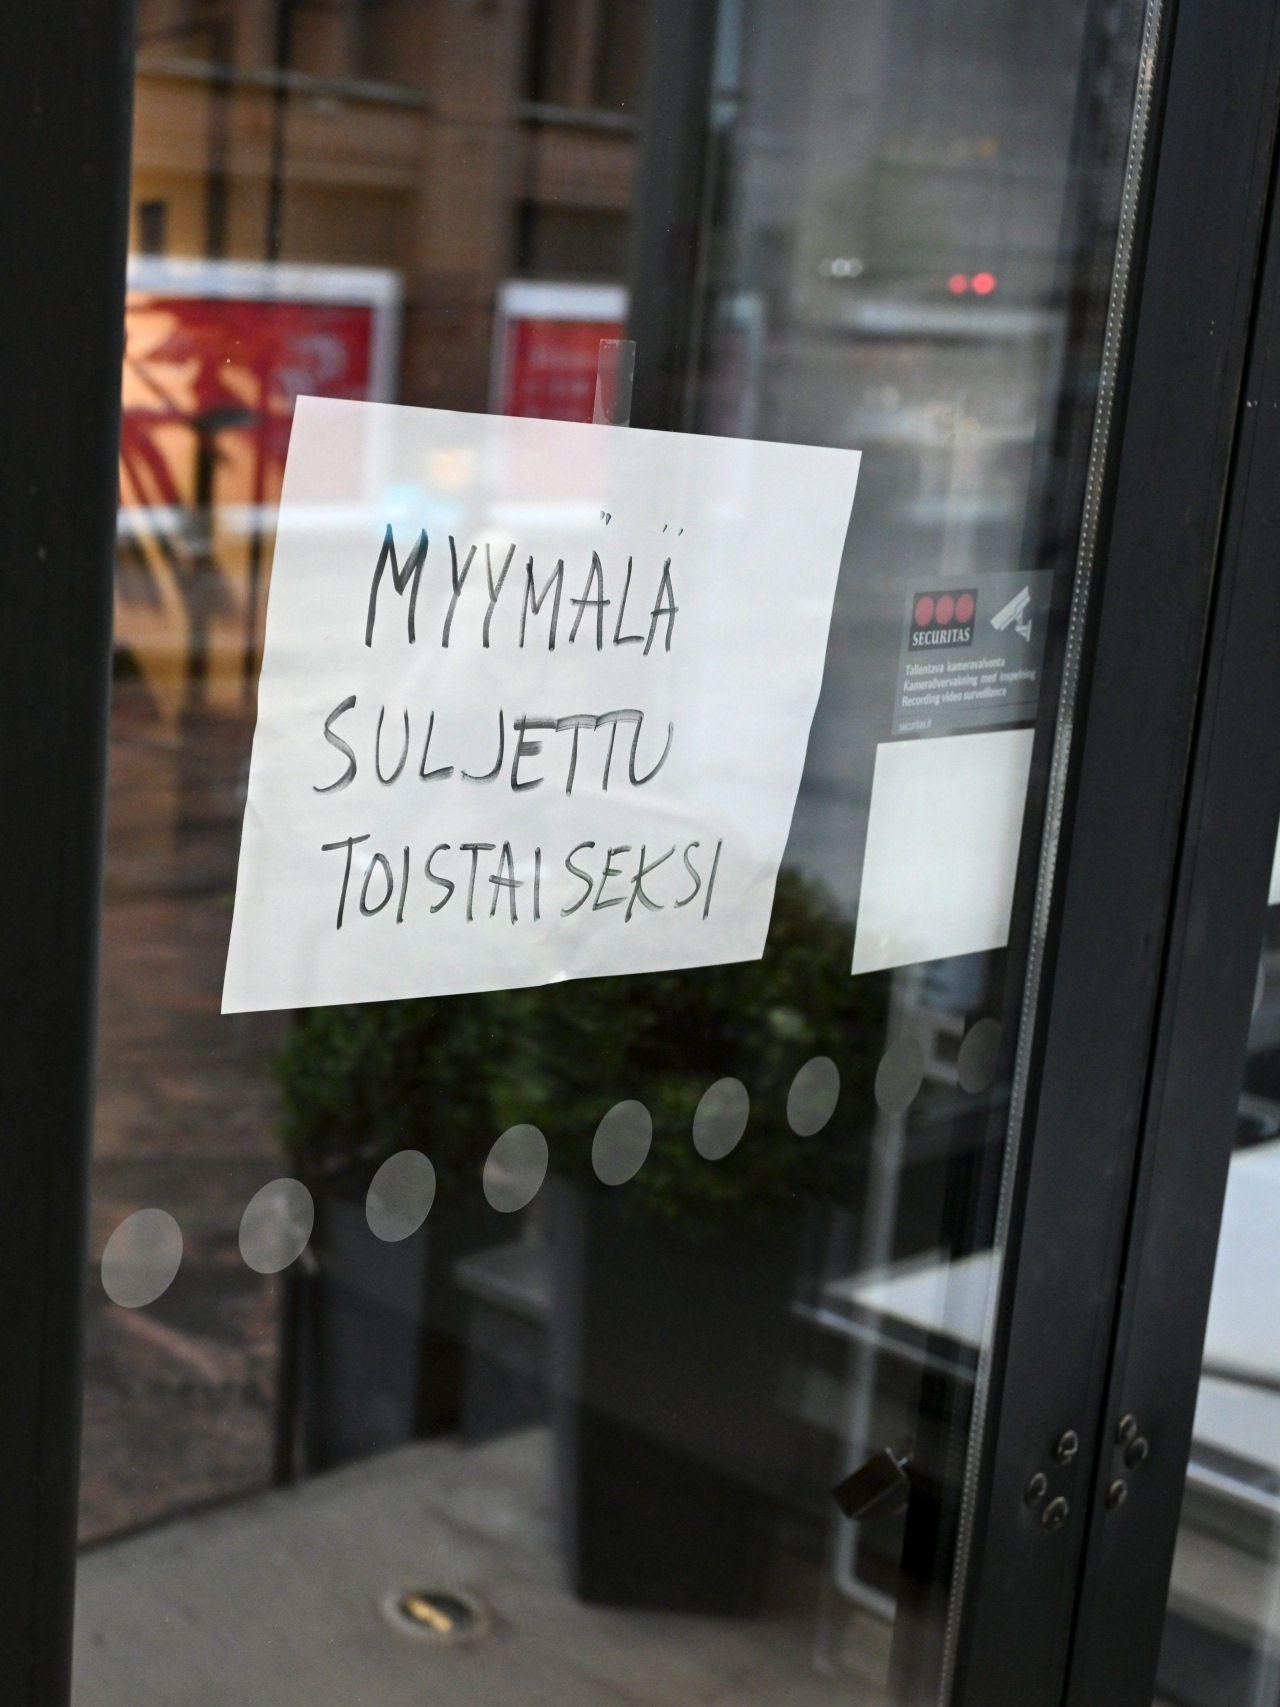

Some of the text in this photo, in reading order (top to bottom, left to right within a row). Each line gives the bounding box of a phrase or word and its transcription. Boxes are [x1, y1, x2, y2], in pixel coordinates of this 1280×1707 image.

[365, 510, 684, 655] MYYMÄLÄ
[912, 627, 971, 646] SECURITAS
[905, 658, 1005, 676] Tallentava kameravalvonta
[981, 671, 997, 683] med
[902, 687, 1007, 707] Recording video surveillance
[313, 695, 674, 796] SULJETTU
[321, 833, 723, 930] TOISTAISEKSI
